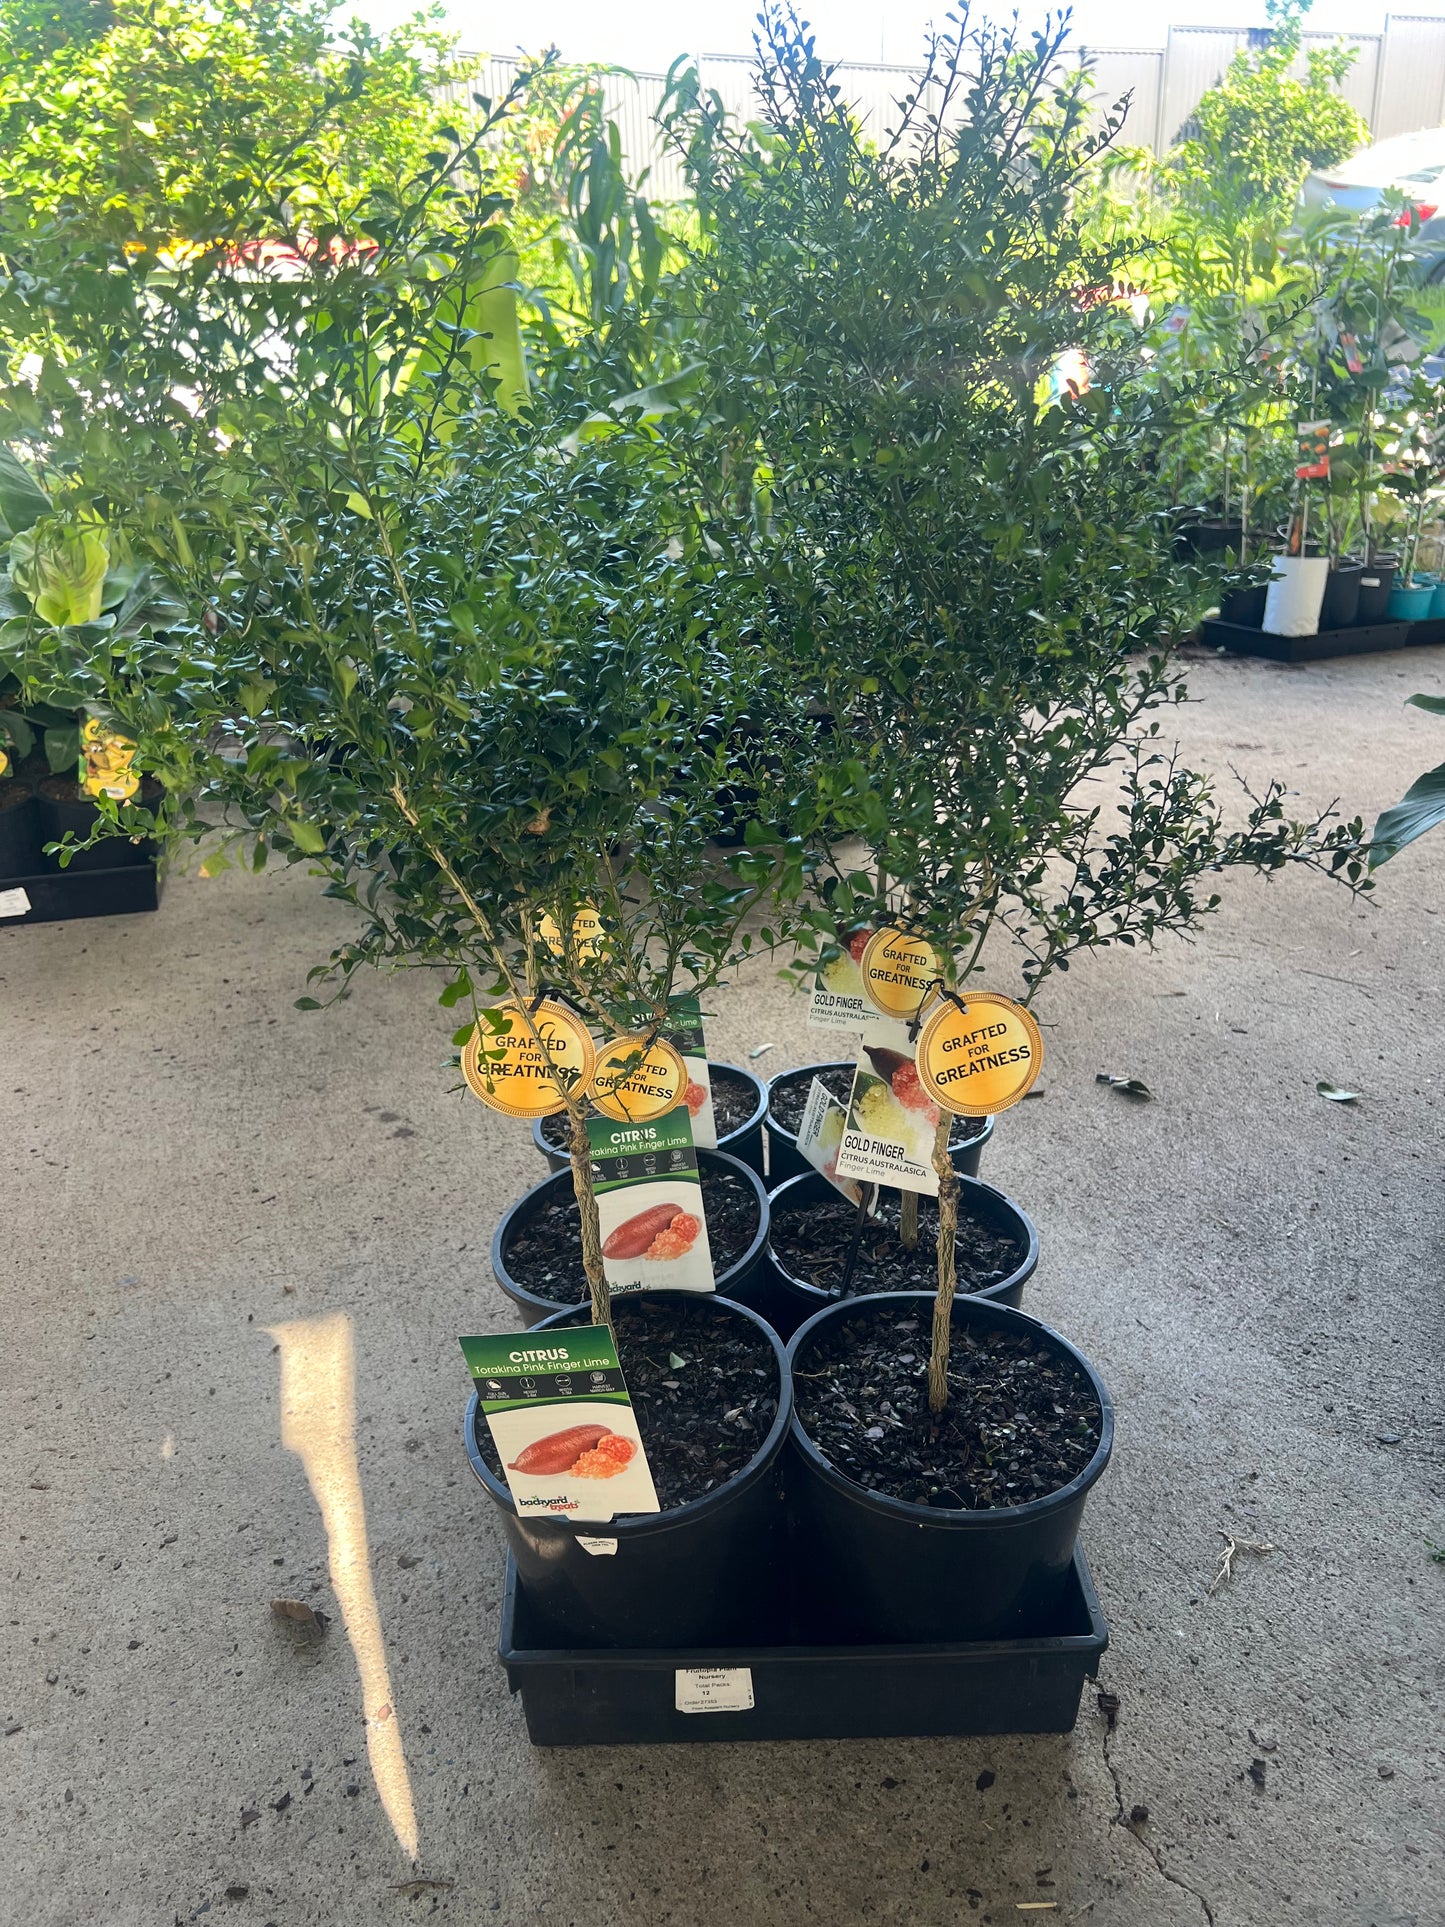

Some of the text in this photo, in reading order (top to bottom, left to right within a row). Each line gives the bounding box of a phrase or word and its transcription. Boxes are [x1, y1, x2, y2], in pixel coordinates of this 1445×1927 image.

[883, 949, 927, 966] GRAFTED
[896, 964, 910, 973] FOR
[870, 968, 932, 992] GREATNESS
[815, 994, 862, 1010] GOLD FINGER
[810, 1008, 879, 1020] CITRUS AUSTRALA
[942, 1023, 1007, 1052] GRAFTED
[520, 1052, 542, 1062] FOR
[968, 1044, 990, 1058] FOR
[936, 1046, 1030, 1085] GREATNESS
[812, 1092, 828, 1138] GOLD FINGER
[610, 1128, 656, 1144] CITRUS
[590, 1148, 618, 1156] rakina
[620, 1143, 637, 1152] Pink
[667, 1136, 688, 1146] Lime
[844, 1135, 905, 1160] GOLD FINGER
[840, 1161, 886, 1176] Finger Lime
[841, 1152, 926, 1177] CITRUS AUSTRALASICA
[608, 1281, 641, 1292] ackyard
[509, 1348, 568, 1363] CITRUS
[474, 1358, 610, 1375] Torakina Pink Finger Lime
[519, 1496, 568, 1506] backyard
[550, 1502, 578, 1510] treats
